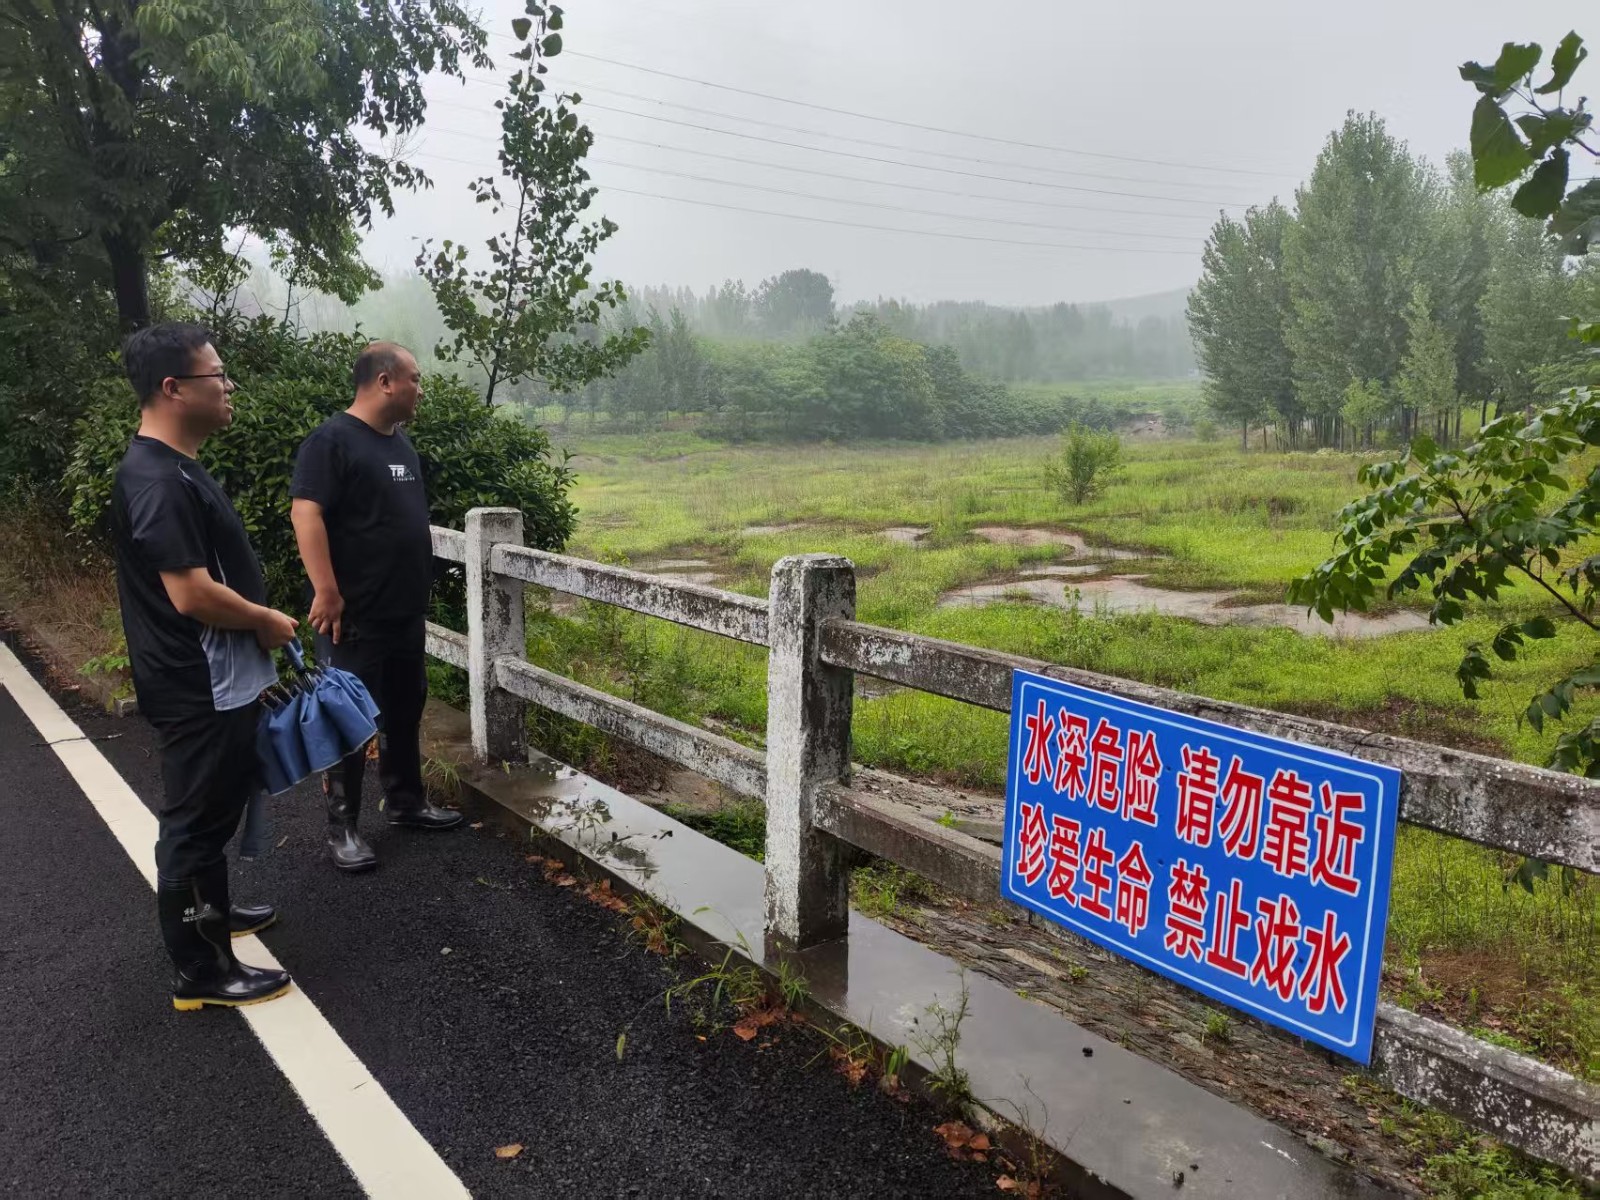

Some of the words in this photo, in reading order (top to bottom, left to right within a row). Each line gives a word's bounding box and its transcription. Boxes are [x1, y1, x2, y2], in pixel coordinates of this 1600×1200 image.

[1023, 699, 1162, 826] 水深危险
[1176, 743, 1366, 897] 请勿靠近
[1016, 803, 1154, 937] 珍爱生命
[1164, 858, 1352, 1014] 禁止戏水
